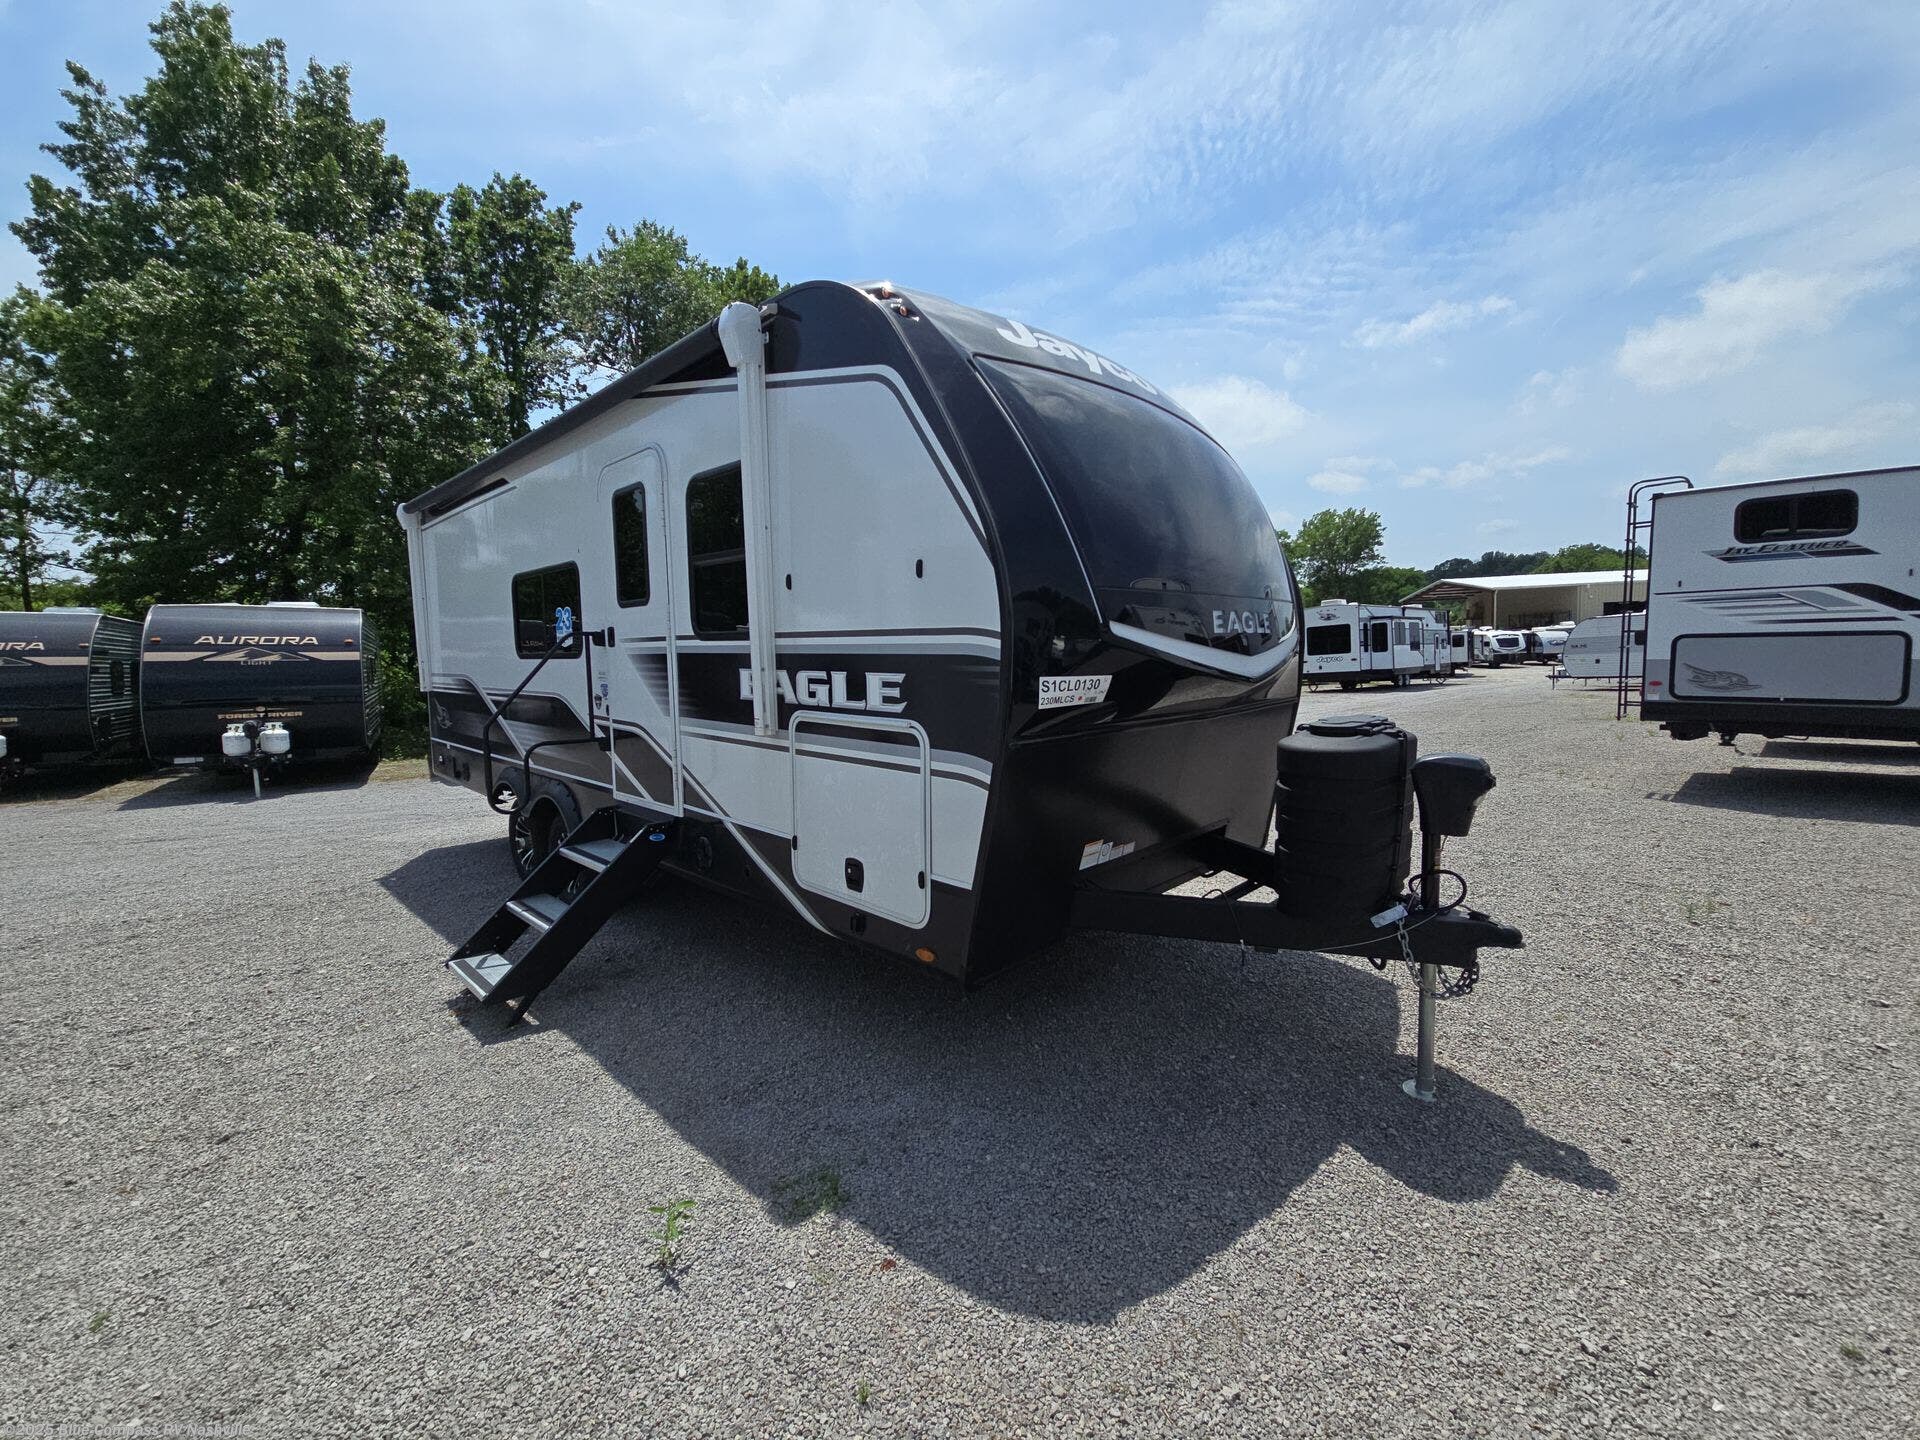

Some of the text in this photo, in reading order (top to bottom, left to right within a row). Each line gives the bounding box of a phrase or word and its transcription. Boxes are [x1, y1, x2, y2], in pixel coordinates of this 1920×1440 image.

[996, 319, 1158, 396] Jayco
[1212, 609, 1271, 635] EAGLE
[193, 635, 319, 645] AURORA
[0, 642, 45, 651] RA
[1041, 678, 1101, 693] S1CL0130
[218, 710, 303, 720] FOREST RIVER
